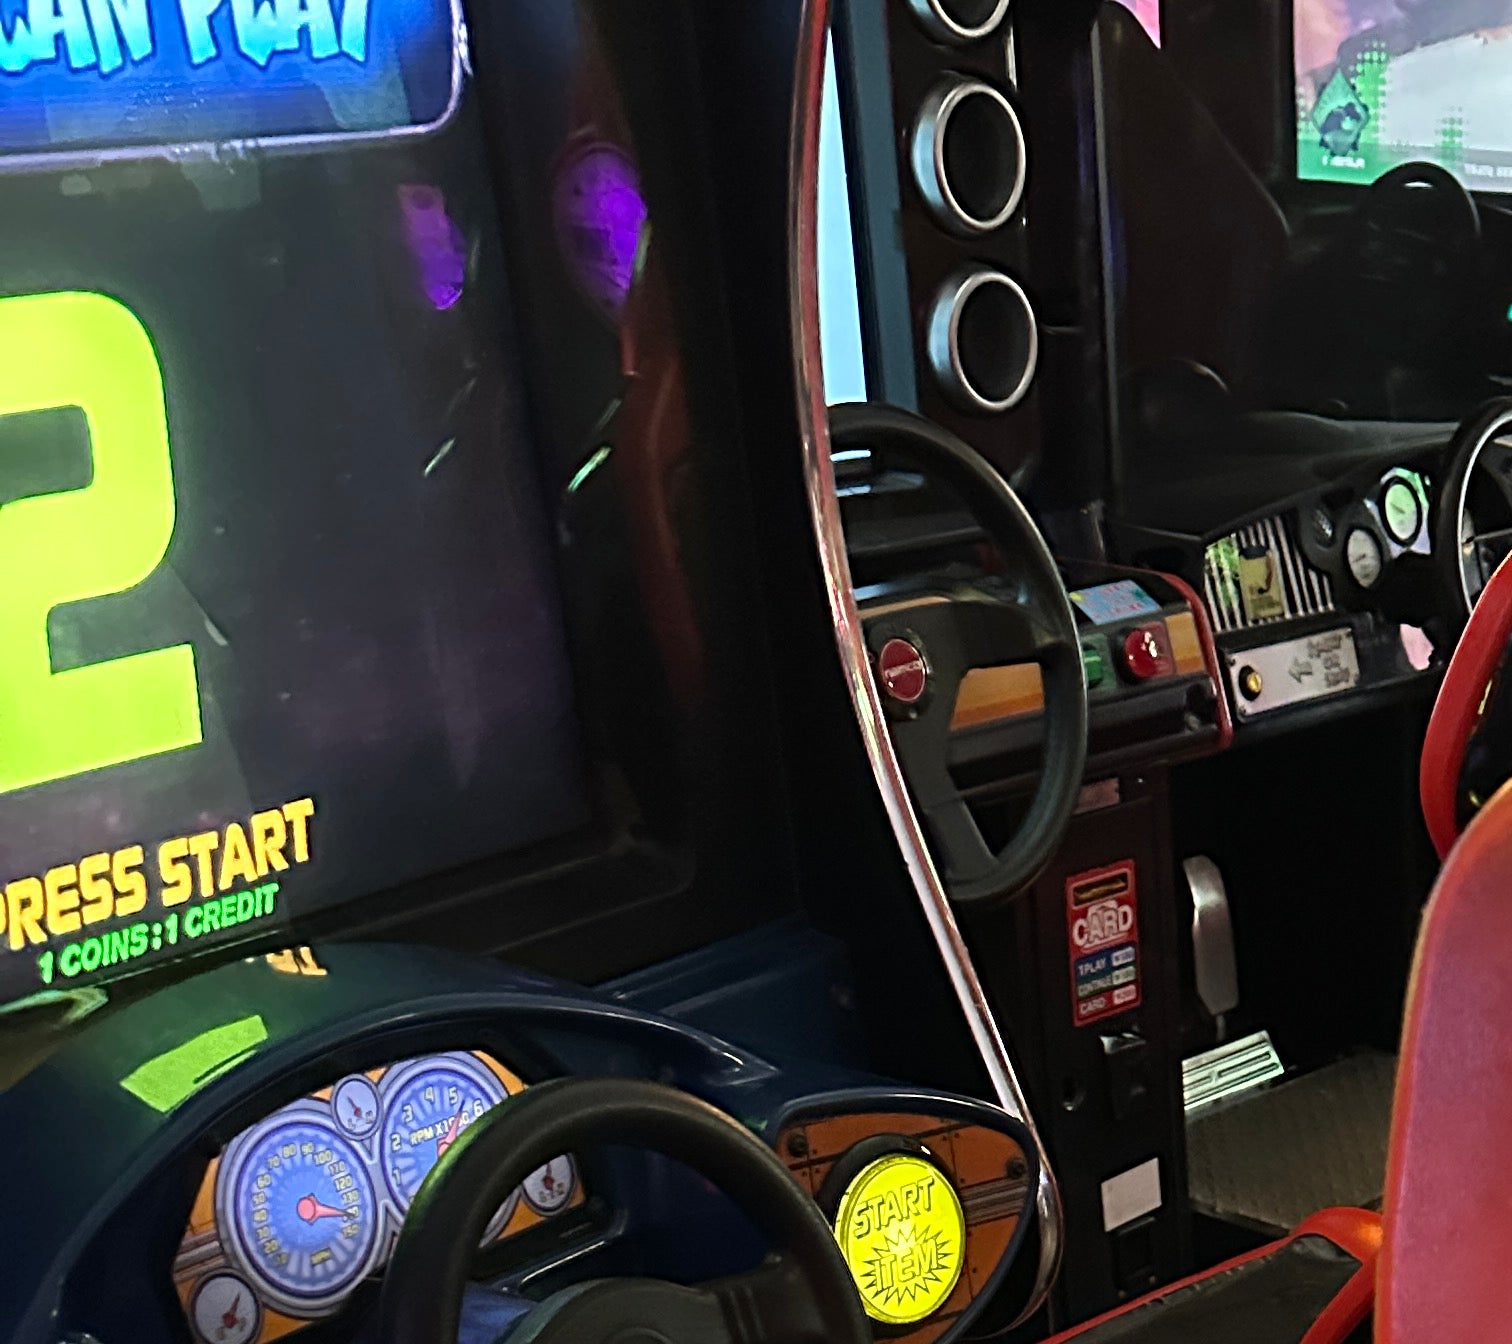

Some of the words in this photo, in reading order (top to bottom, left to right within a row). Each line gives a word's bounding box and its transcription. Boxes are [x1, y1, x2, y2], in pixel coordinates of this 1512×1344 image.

[0, 845, 148, 951] RESS
[157, 798, 315, 908] START
[183, 882, 280, 938] CREDIT
[1072, 901, 1133, 946] CARD
[424, 1086, 436, 1104] 4
[448, 1086, 459, 1106] 5
[402, 1104, 414, 1123] 3
[472, 1098, 485, 1119] 6
[390, 1133, 402, 1153] 2
[408, 1125, 434, 1147] RPM
[312, 1149, 333, 1167] 100
[334, 1174, 353, 1192] 120
[853, 1175, 935, 1240] START
[873, 1235, 938, 1293] ITEM
